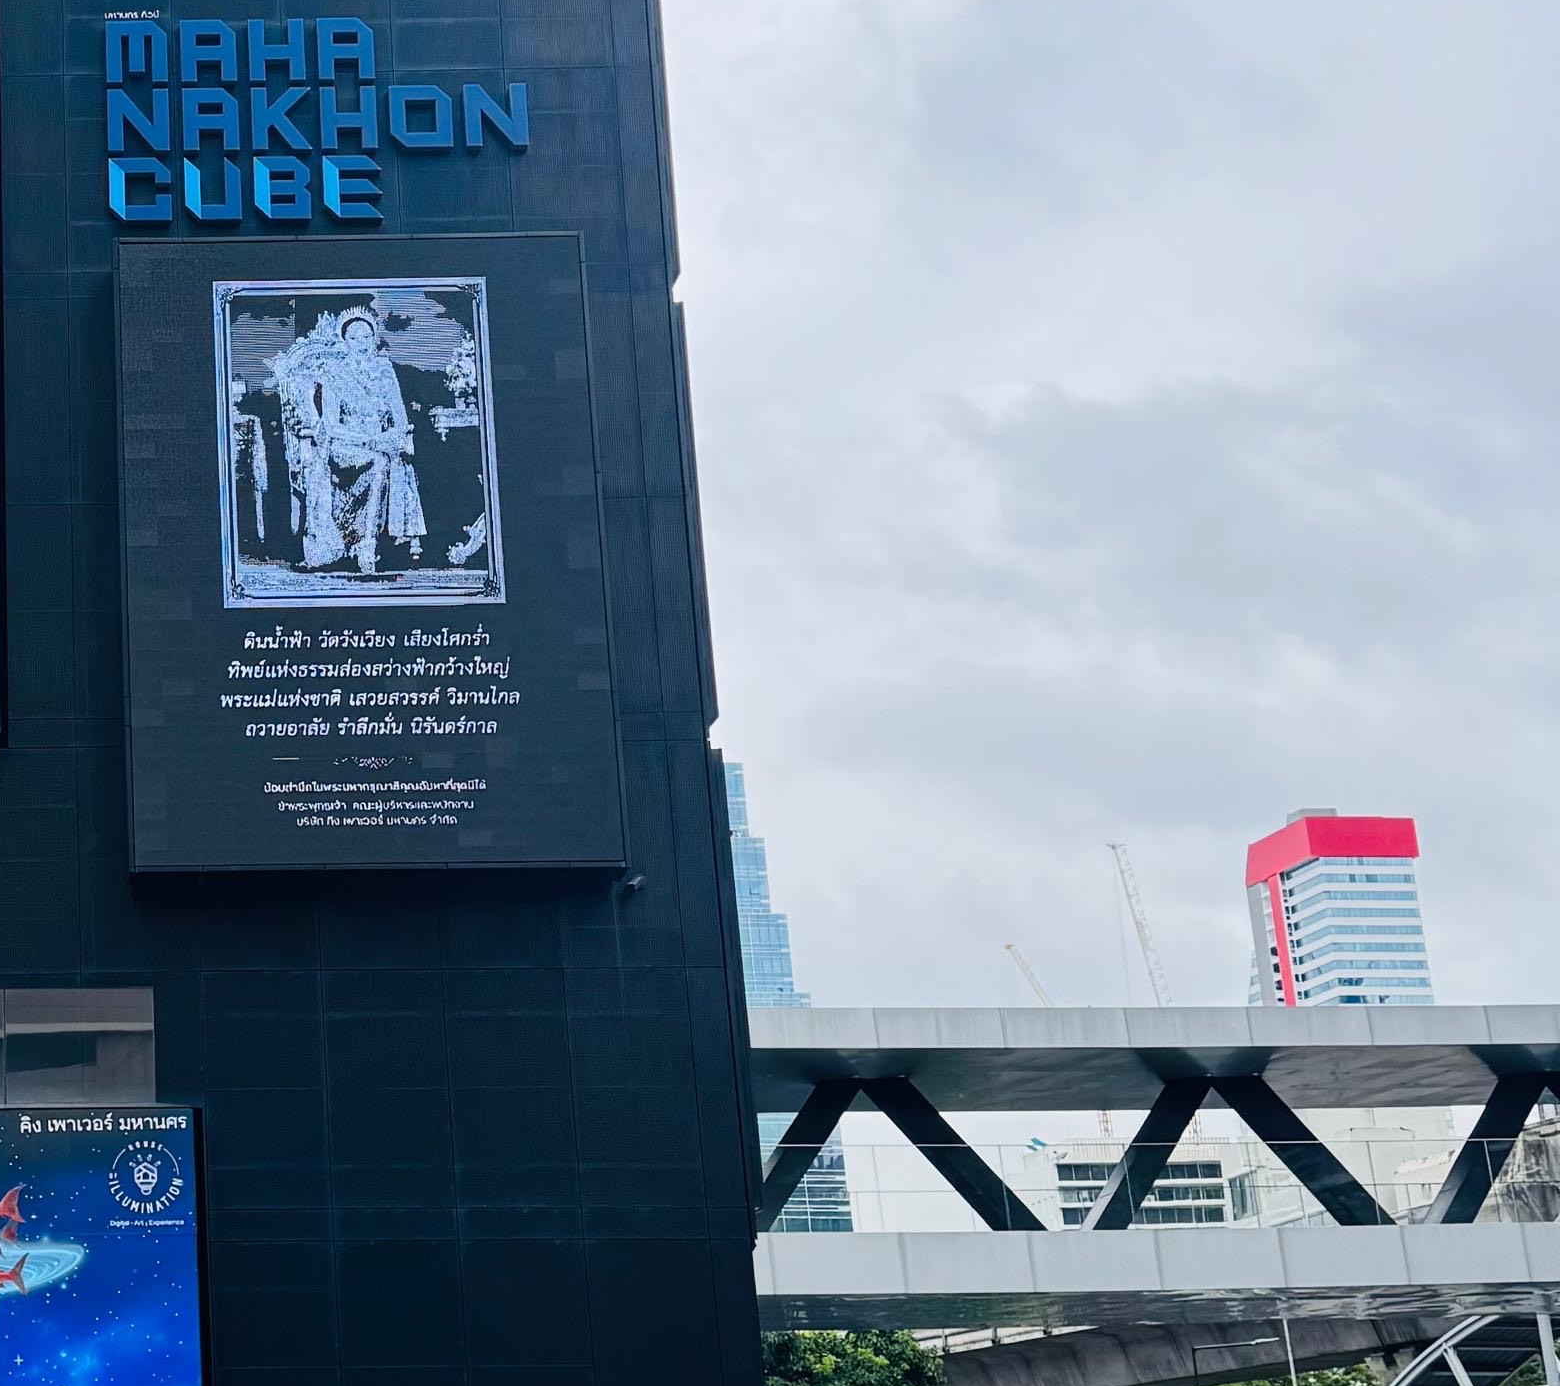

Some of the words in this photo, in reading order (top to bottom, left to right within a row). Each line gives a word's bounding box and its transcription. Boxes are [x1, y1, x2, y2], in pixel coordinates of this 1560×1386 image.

[105, 17, 377, 84] MAHA
[107, 83, 530, 151] NAKHON
[108, 155, 385, 221] CUBE
[243, 625, 311, 650] ดินน้ำฟ้า
[403, 623, 490, 648] เสียงโศกร่ำ
[220, 688, 342, 709] พระแม่แห่งชาติ
[349, 686, 440, 707] เสวยสวรรค์
[446, 685, 521, 706] วิมานไกล
[245, 716, 331, 737] ถวายอาลัย
[411, 715, 498, 736] นิรันดร์กาล
[20, 1115, 42, 1134] คิง
[47, 1111, 113, 1133] เพาเวอร์
[109, 1178, 184, 1213] ILLUMINATION
